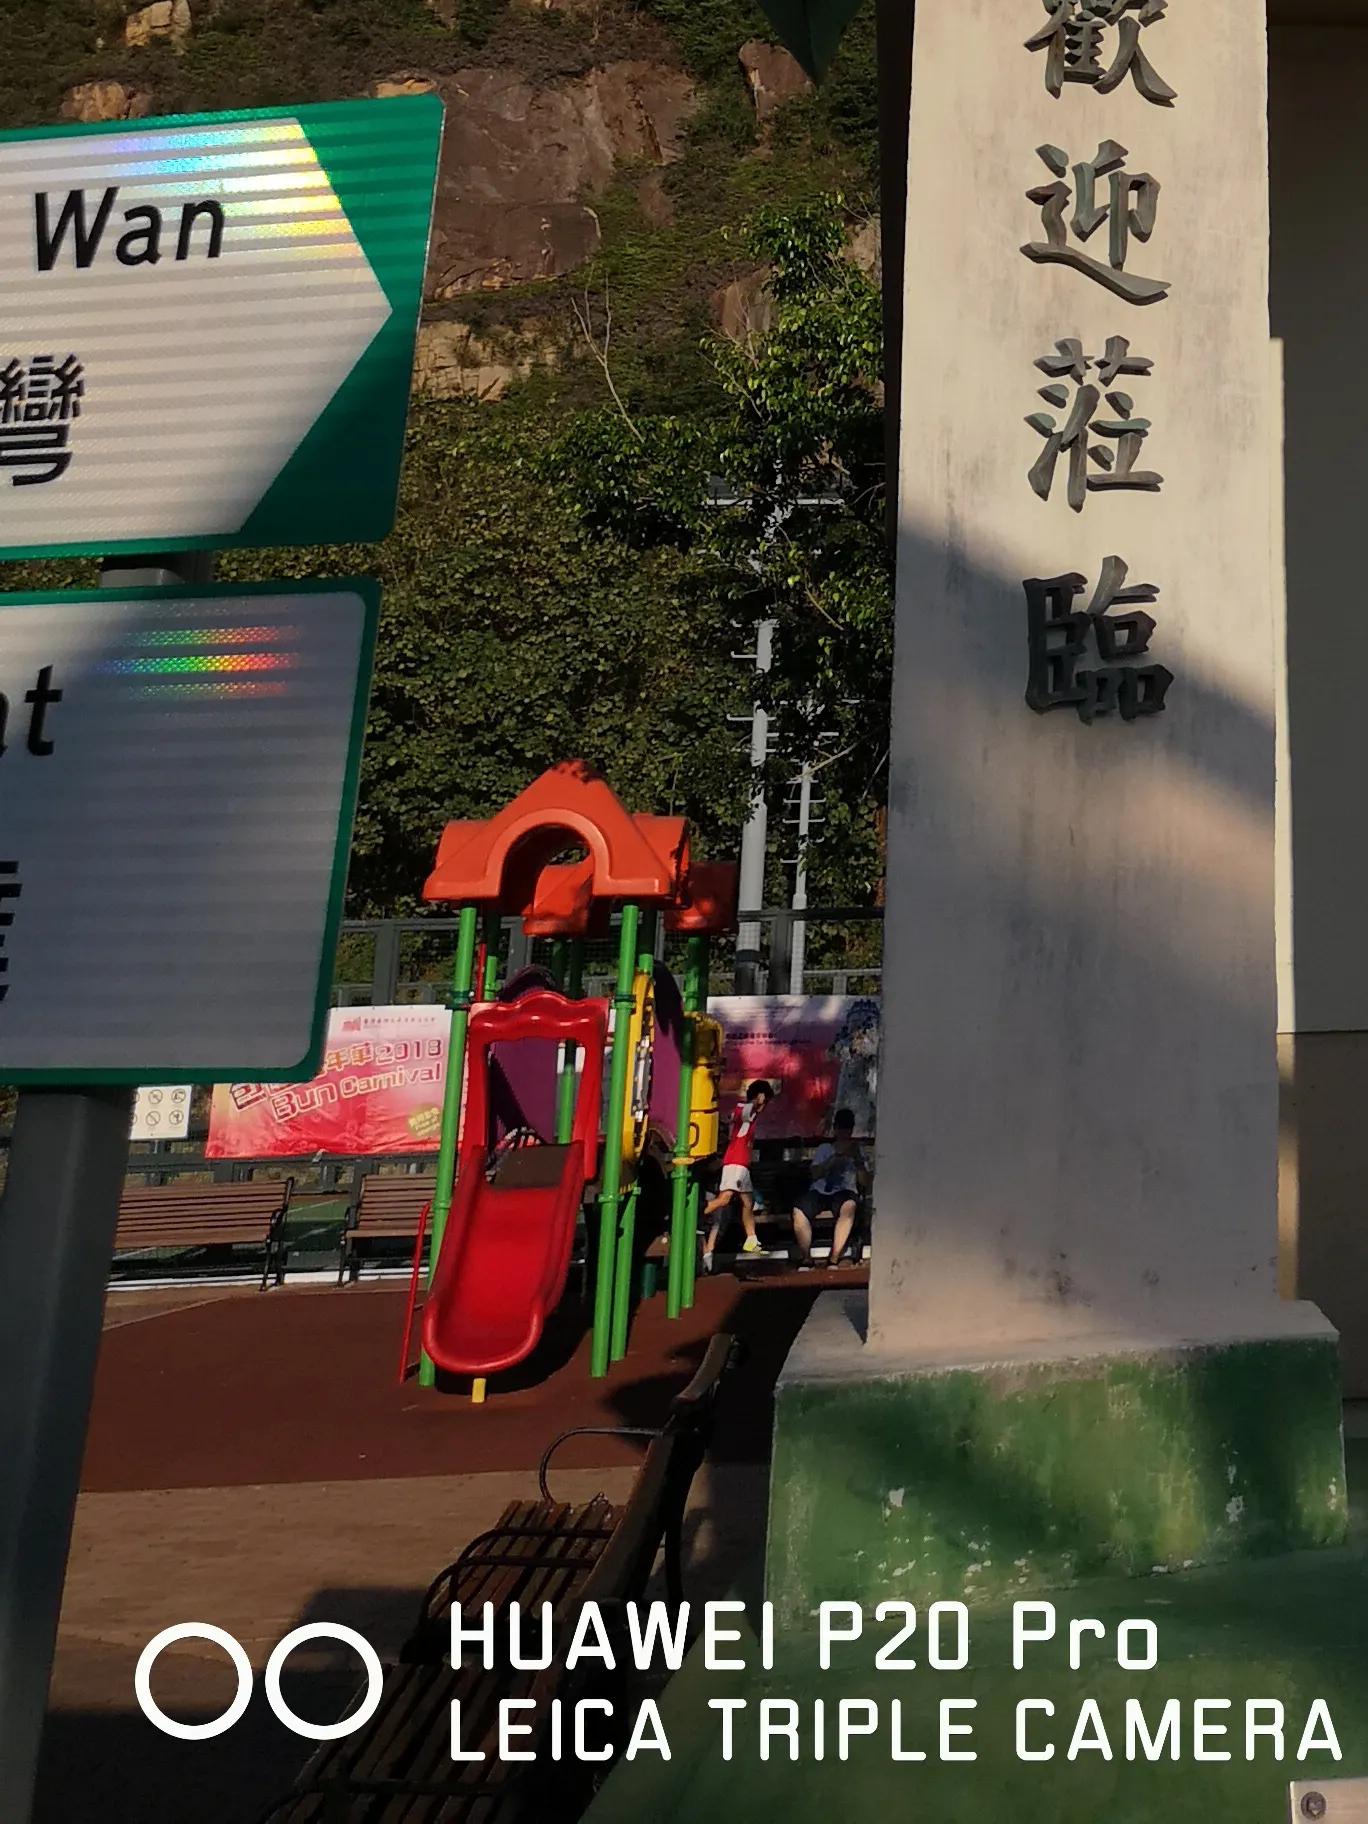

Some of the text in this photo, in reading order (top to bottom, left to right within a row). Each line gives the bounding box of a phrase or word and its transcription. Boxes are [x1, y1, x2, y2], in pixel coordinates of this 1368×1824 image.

[34, 186, 226, 271] Wan
[270, 1083, 337, 1124] Bun
[340, 1062, 443, 1100] Carnival
